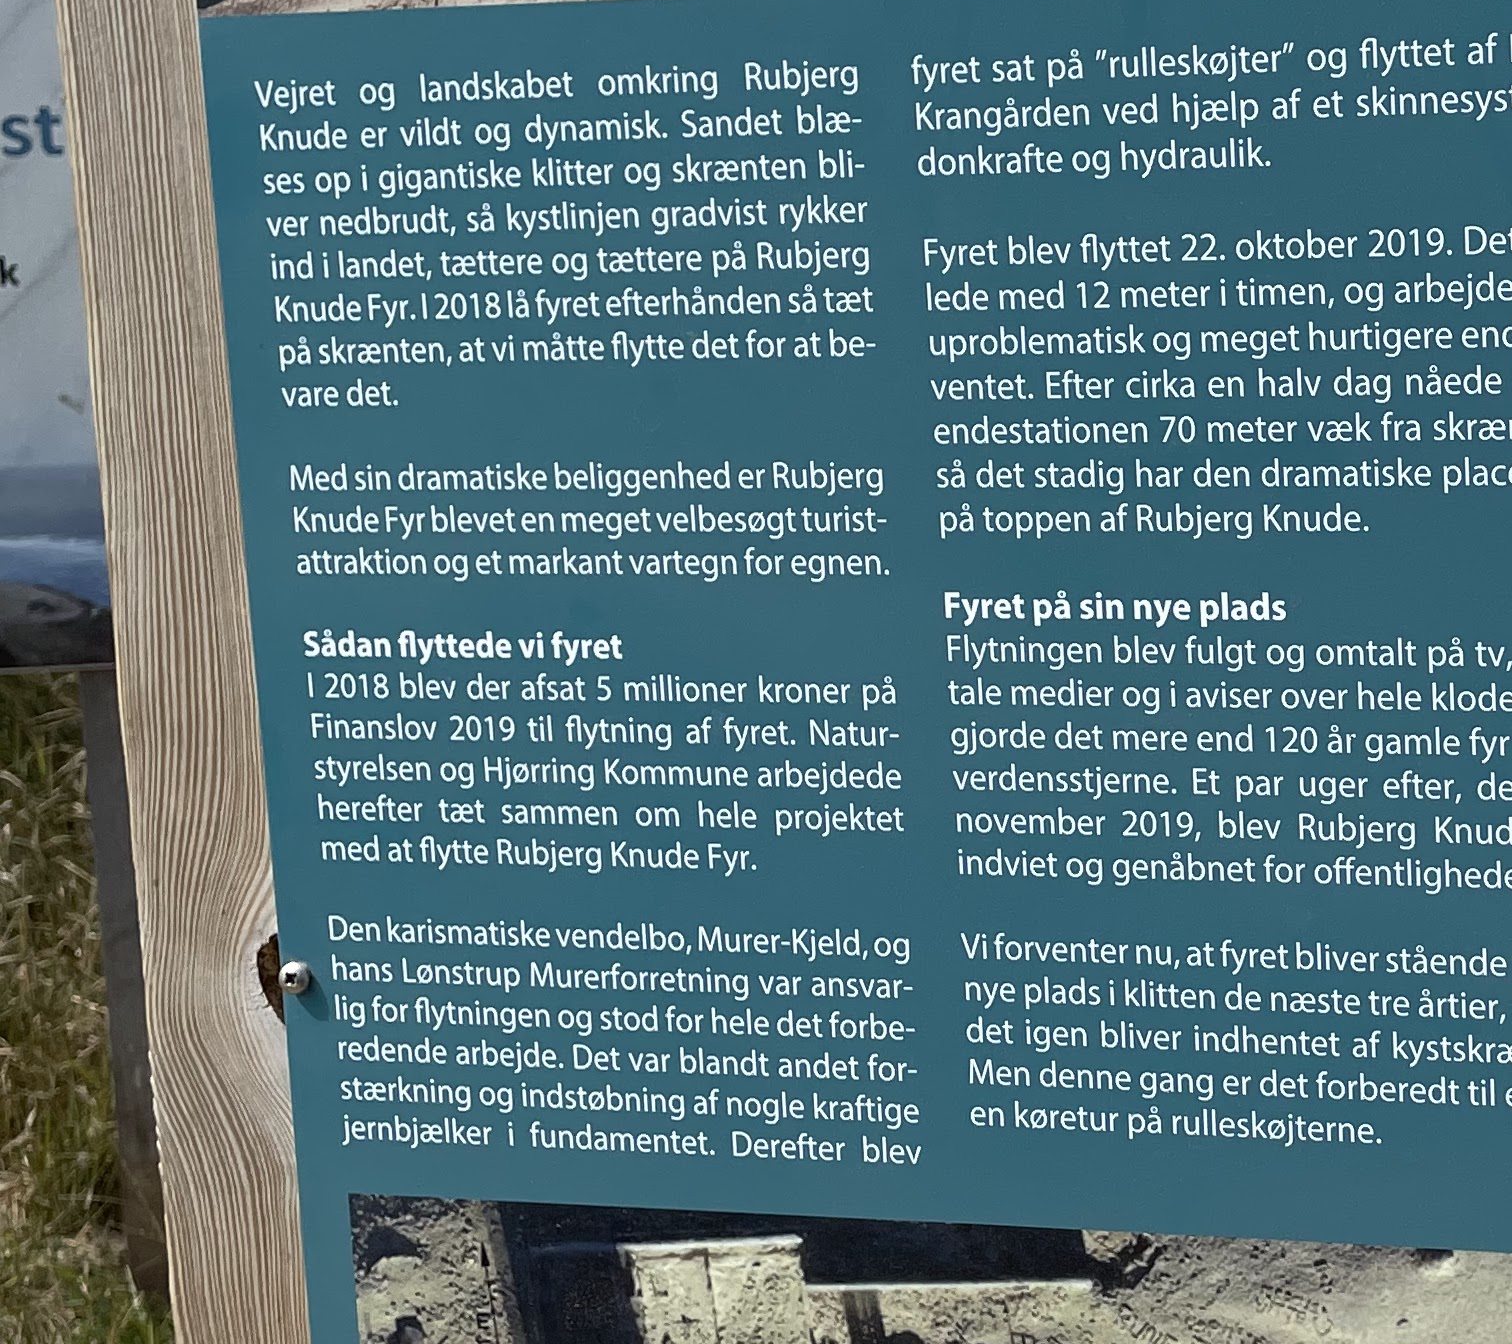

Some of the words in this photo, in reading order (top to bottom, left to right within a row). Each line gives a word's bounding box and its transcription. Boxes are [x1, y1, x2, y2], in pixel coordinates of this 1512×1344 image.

[253, 79, 337, 115] Vejret
[359, 82, 395, 111] og
[419, 69, 574, 103] landskabet
[597, 64, 718, 100] omkring
[744, 59, 859, 97] Rubjerg
[259, 120, 348, 152] Knude
[360, 126, 388, 149] er
[399, 116, 462, 147] vildt
[474, 122, 511, 152] og
[524, 109, 668, 151] dynamisk.
[681, 106, 783, 138] Sandet
[796, 104, 863, 135] blæ-
[915, 96, 1090, 137] Krangården
[1102, 92, 1159, 125] ved
[1172, 90, 1259, 131] hjælp
[1272, 87, 1302, 120] af
[1312, 90, 1344, 119] et
[917, 142, 1064, 177] donkrafte
[1071, 149, 1111, 180] og
[1120, 136, 1271, 179] hydraulik.
[929, 323, 1146, 363] uproblematisk
[1152, 331, 1191, 361] og
[1200, 325, 1300, 360] meget
[1308, 320, 1453, 358] hurtigere
[293, 504, 380, 533] Knude
[384, 506, 426, 540] Fyr
[430, 504, 517, 533] blevet
[520, 512, 555, 533] en
[560, 507, 652, 540] meget
[655, 504, 797, 540] velbesøgt
[800, 504, 887, 533] turist-
[944, 591, 1026, 627] Fyret
[1032, 589, 1072, 627] på
[1079, 591, 1125, 620] sin
[1133, 599, 1191, 628] nye
[1199, 591, 1287, 628] plads
[303, 628, 392, 658] Sådan
[397, 629, 513, 665] flyttede
[517, 631, 545, 659] vi
[550, 630, 623, 667] fyret
[314, 753, 432, 787] styrelsen
[439, 762, 475, 790] og
[483, 756, 595, 792] Hjørring
[603, 758, 749, 787] Kommune
[757, 759, 902, 795] arbejdede
[956, 806, 1106, 836] november
[1122, 810, 1201, 842] 2019,
[1218, 810, 1281, 840] blev
[1298, 812, 1416, 851] Rubjerg
[957, 848, 1058, 878] indviet
[1065, 857, 1103, 886] og
[1112, 851, 1256, 887] genåbnet
[1262, 854, 1306, 884] for
[331, 953, 393, 983] hans
[401, 957, 521, 993] Lønstrup
[530, 961, 749, 1001] Murerforretning
[758, 975, 802, 996] var
[811, 976, 914, 999] ansvar-
